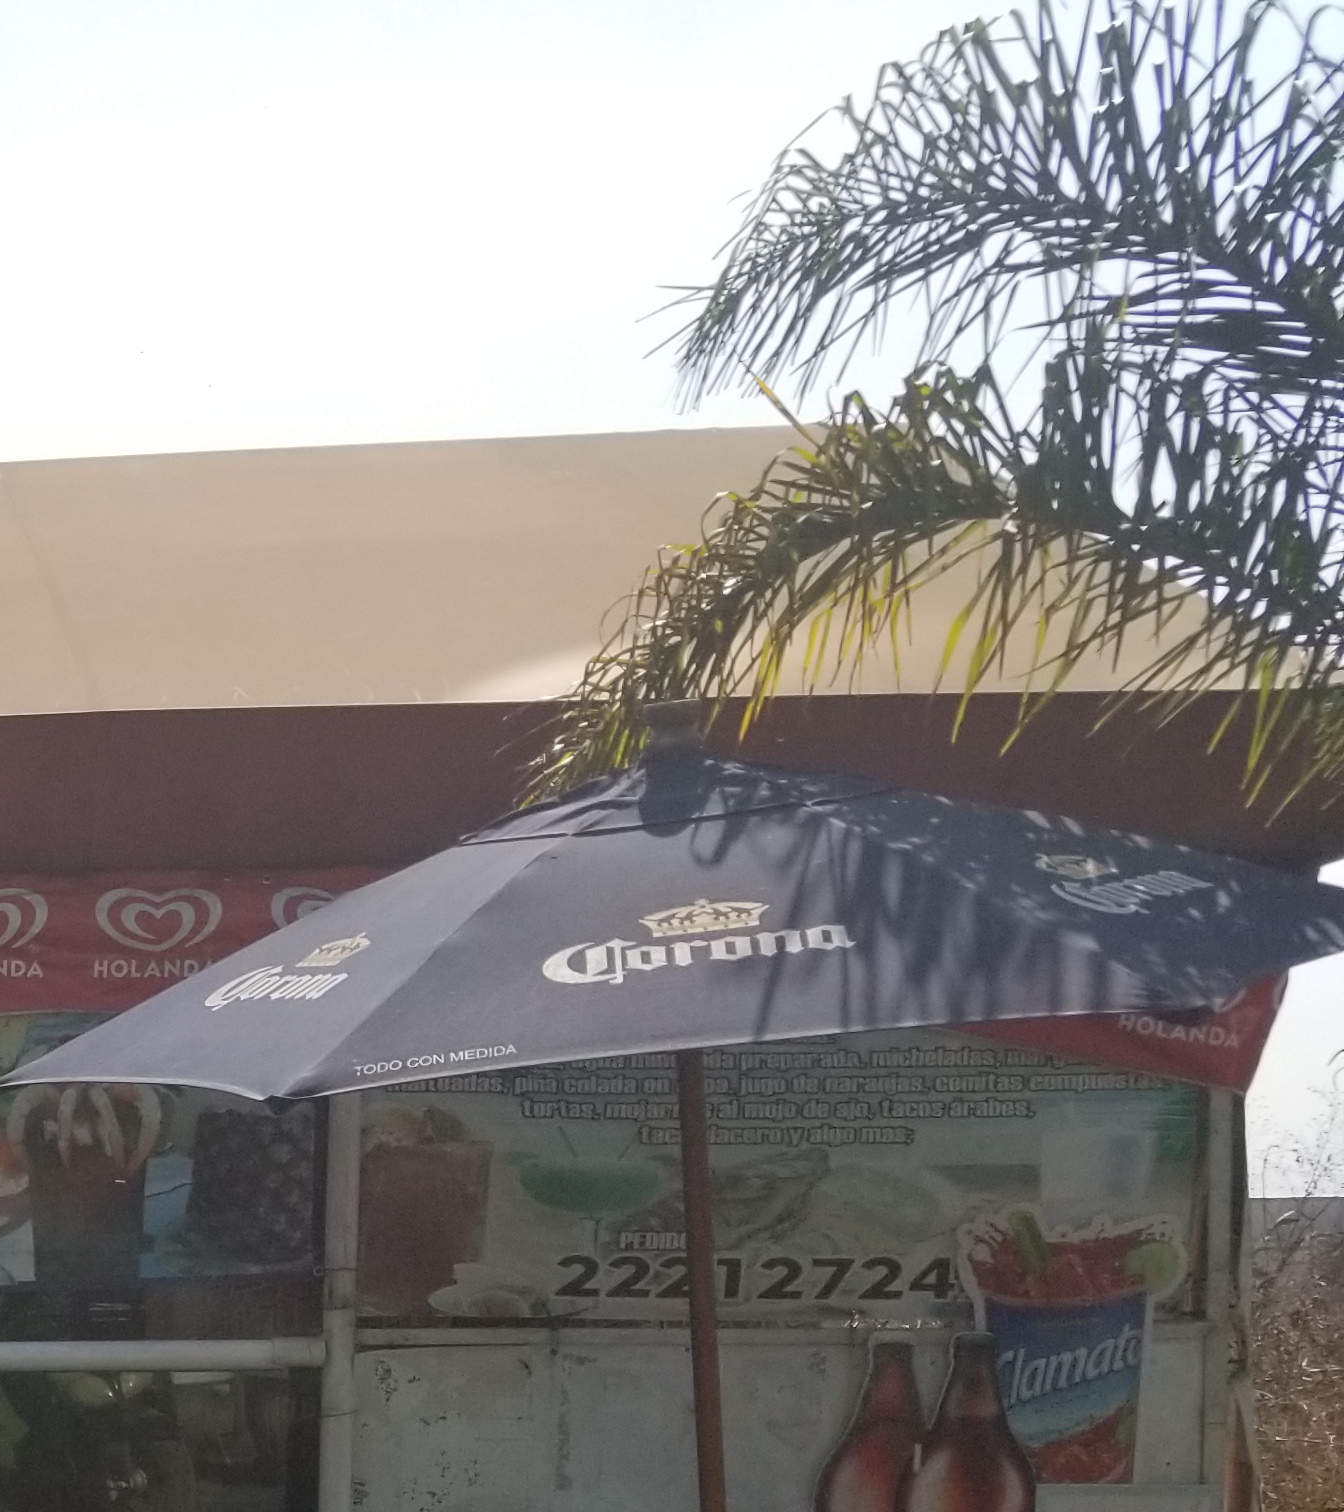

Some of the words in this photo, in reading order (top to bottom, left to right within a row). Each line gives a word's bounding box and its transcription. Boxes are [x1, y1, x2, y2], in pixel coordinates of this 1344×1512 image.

[542, 923, 857, 985] Corona
[204, 965, 349, 1012] Corona
[1117, 1014, 1240, 1049] HOLANDA
[354, 1059, 403, 1077] TODO
[407, 1053, 446, 1069] CON
[449, 1044, 518, 1063] MEDIDA
[564, 1073, 638, 1094] colada
[740, 1073, 787, 1096] jugo
[522, 1099, 601, 1121] tortas,
[879, 1098, 945, 1119] tacos
